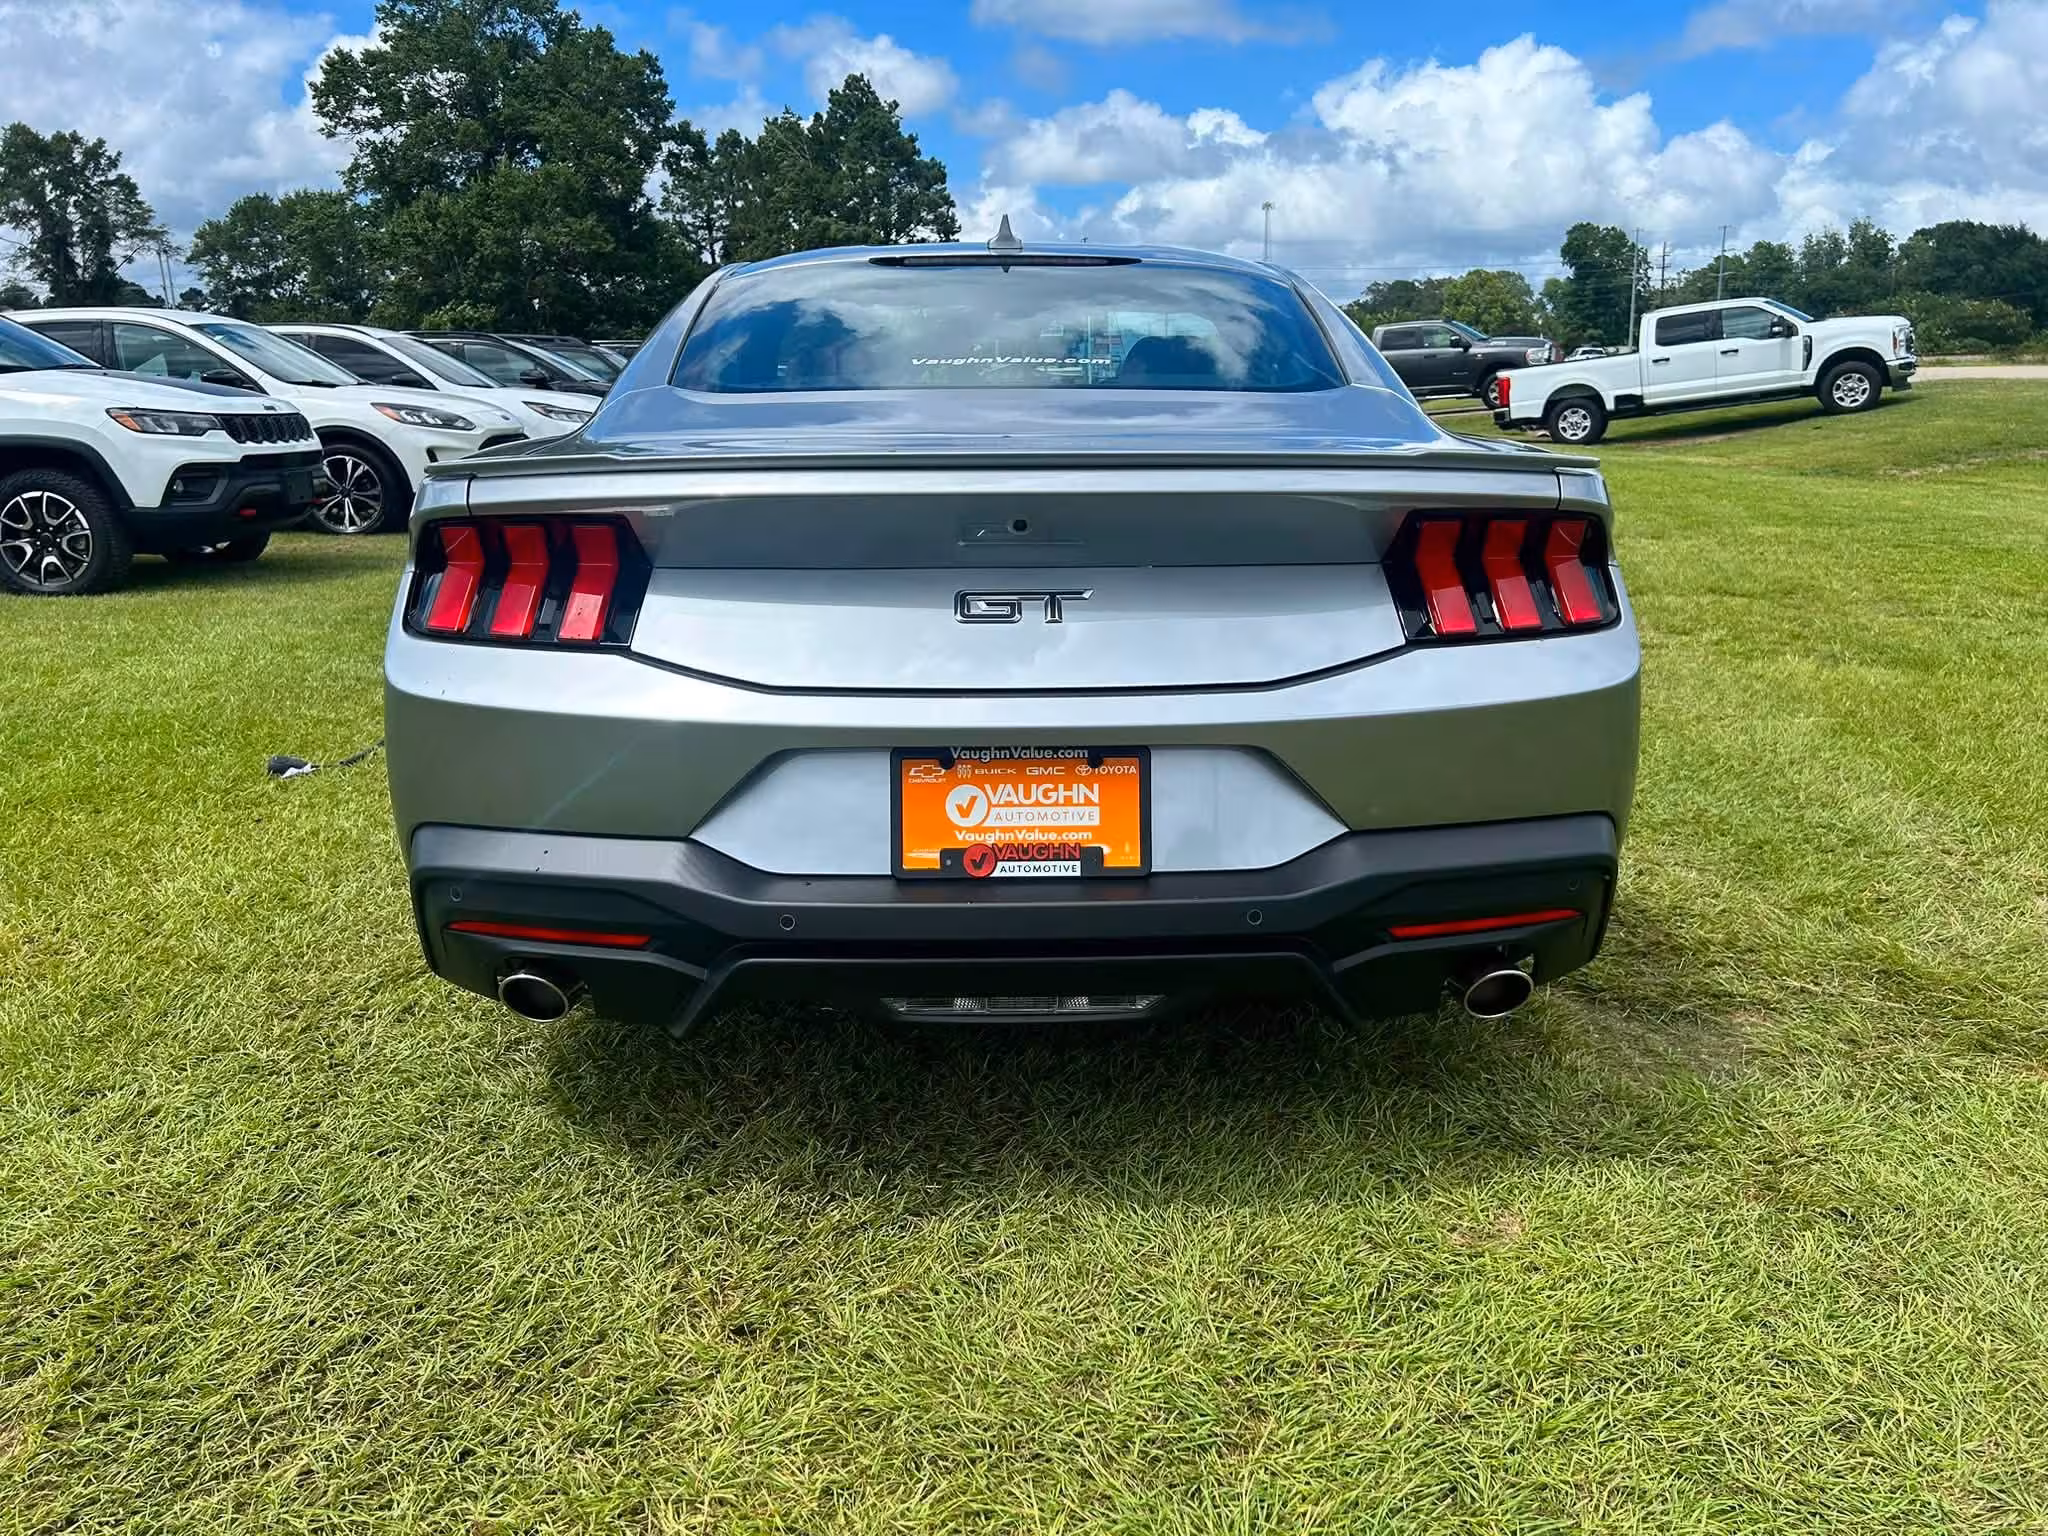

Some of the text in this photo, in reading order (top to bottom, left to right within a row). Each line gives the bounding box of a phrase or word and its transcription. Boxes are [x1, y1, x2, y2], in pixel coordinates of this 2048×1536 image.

[911, 355, 1111, 365] VaughnValue.com
[954, 588, 1094, 624] GT
[951, 747, 1089, 762] VaughnValue.com
[1026, 766, 1065, 775] GMC
[984, 783, 1099, 804] VAUGHN
[994, 811, 1095, 821] AUTOMOTIVE
[955, 829, 1092, 842] VaughnValue.com
[992, 843, 1080, 860] VAUGHN
[1000, 864, 1077, 873] AUTOMOTIVE
